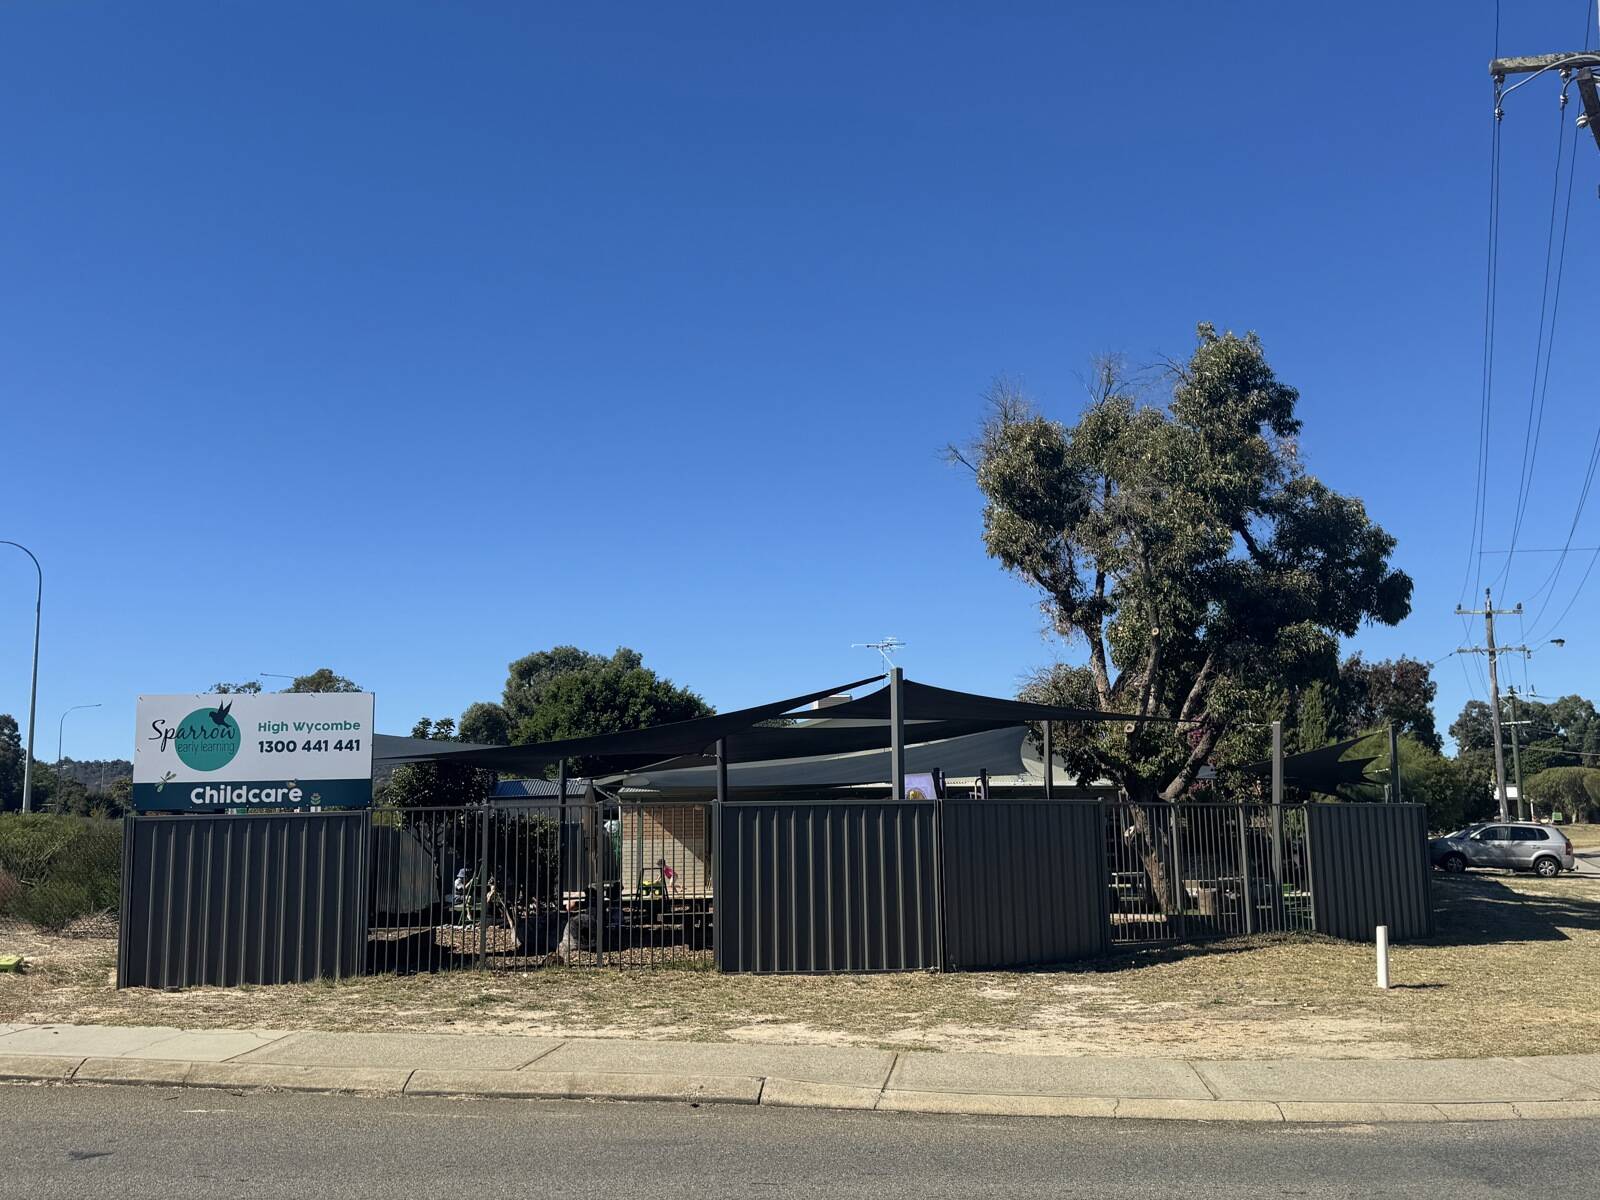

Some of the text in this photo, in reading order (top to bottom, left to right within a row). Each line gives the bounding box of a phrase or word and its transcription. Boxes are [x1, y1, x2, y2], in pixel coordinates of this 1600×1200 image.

[258, 720, 361, 735] High Wycombe
[148, 719, 236, 753] Sparrow
[177, 741, 235, 756] early learning
[258, 739, 361, 753] 1300 441 441
[190, 785, 303, 804] Childcare
